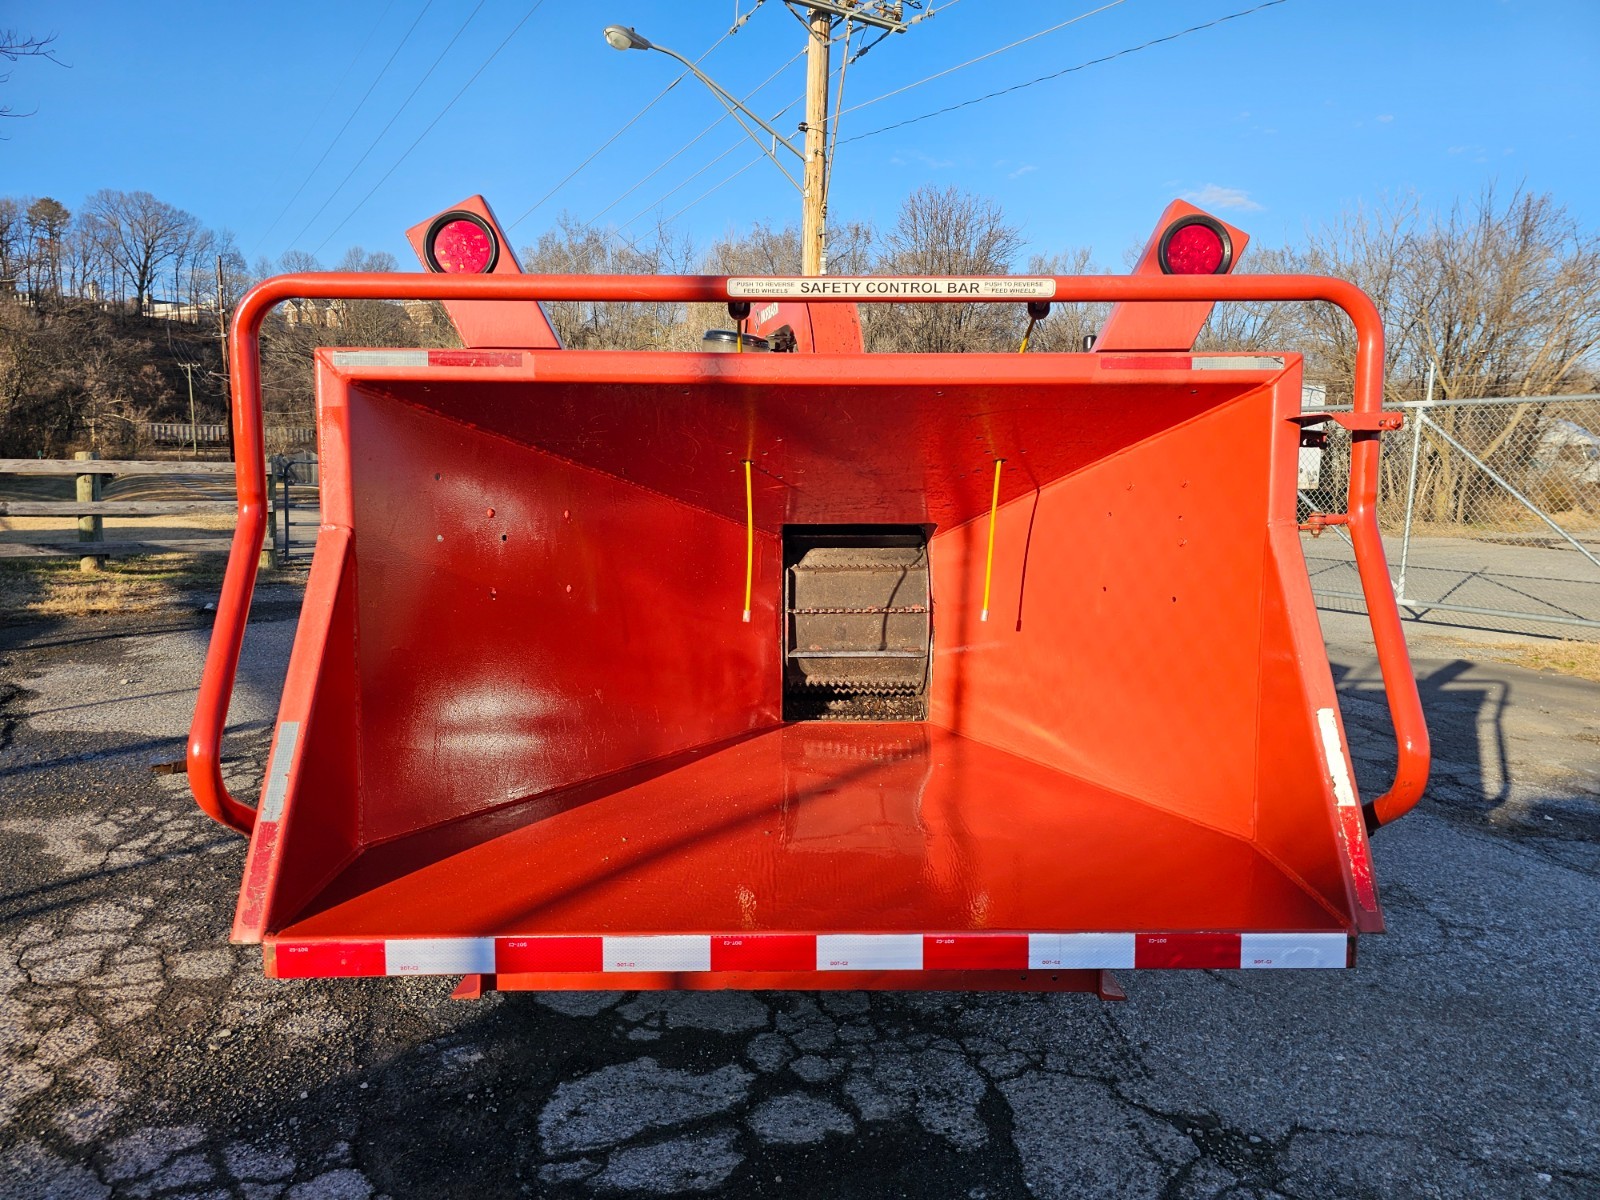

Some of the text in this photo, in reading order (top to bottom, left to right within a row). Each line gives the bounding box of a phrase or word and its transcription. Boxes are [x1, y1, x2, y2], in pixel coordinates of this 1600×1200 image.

[800, 282, 981, 294] SAFETY CONTROL BAR
